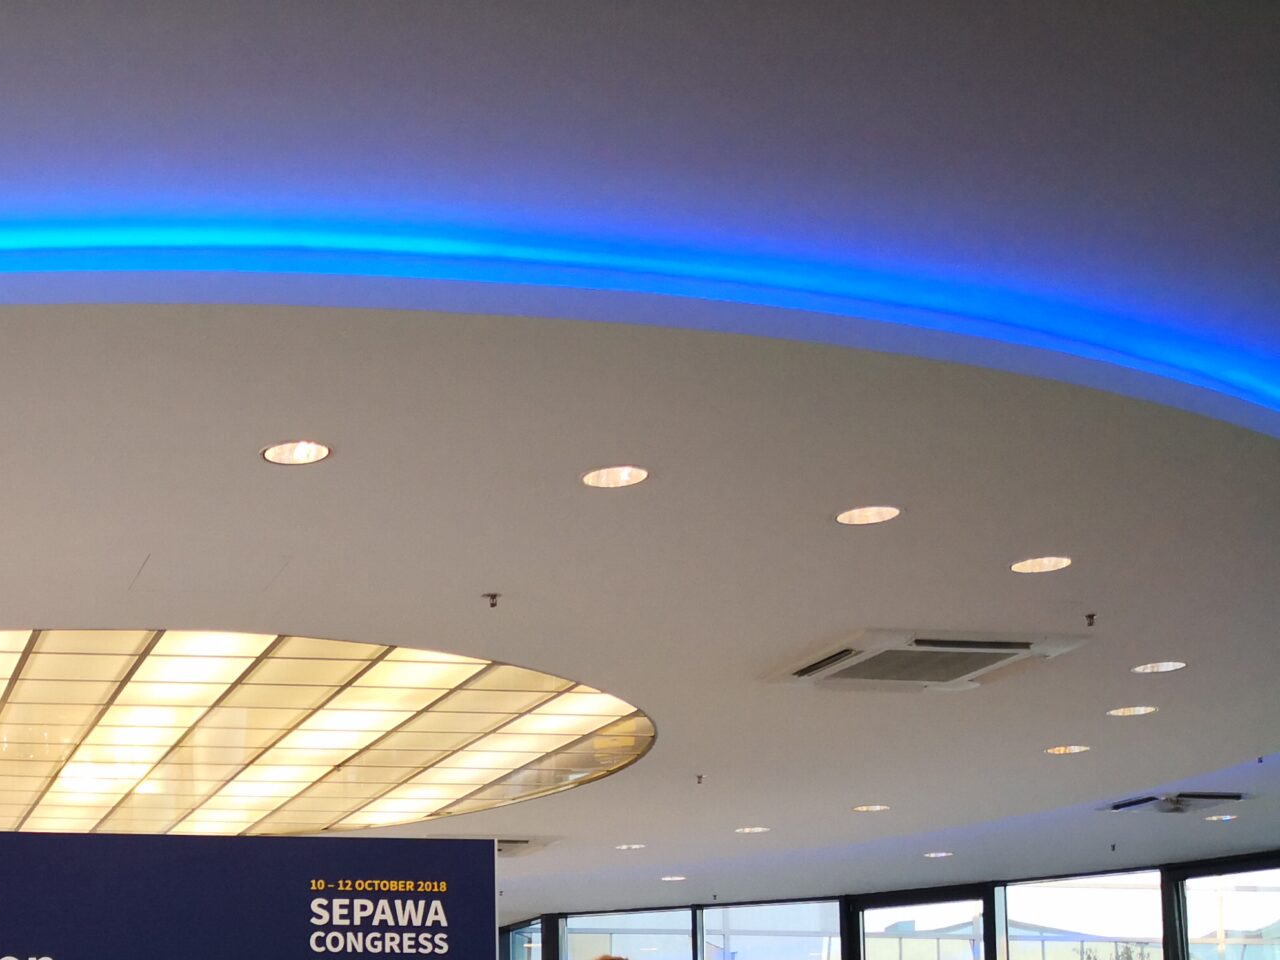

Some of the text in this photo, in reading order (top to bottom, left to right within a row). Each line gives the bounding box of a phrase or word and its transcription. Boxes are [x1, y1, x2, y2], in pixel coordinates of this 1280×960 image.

[310, 879, 325, 891] 10
[337, 880, 353, 891] 12
[355, 880, 414, 892] OCTOBER
[417, 881, 447, 892] 2018
[310, 898, 448, 927] SEPAWA
[309, 931, 449, 954] CONGRESS
